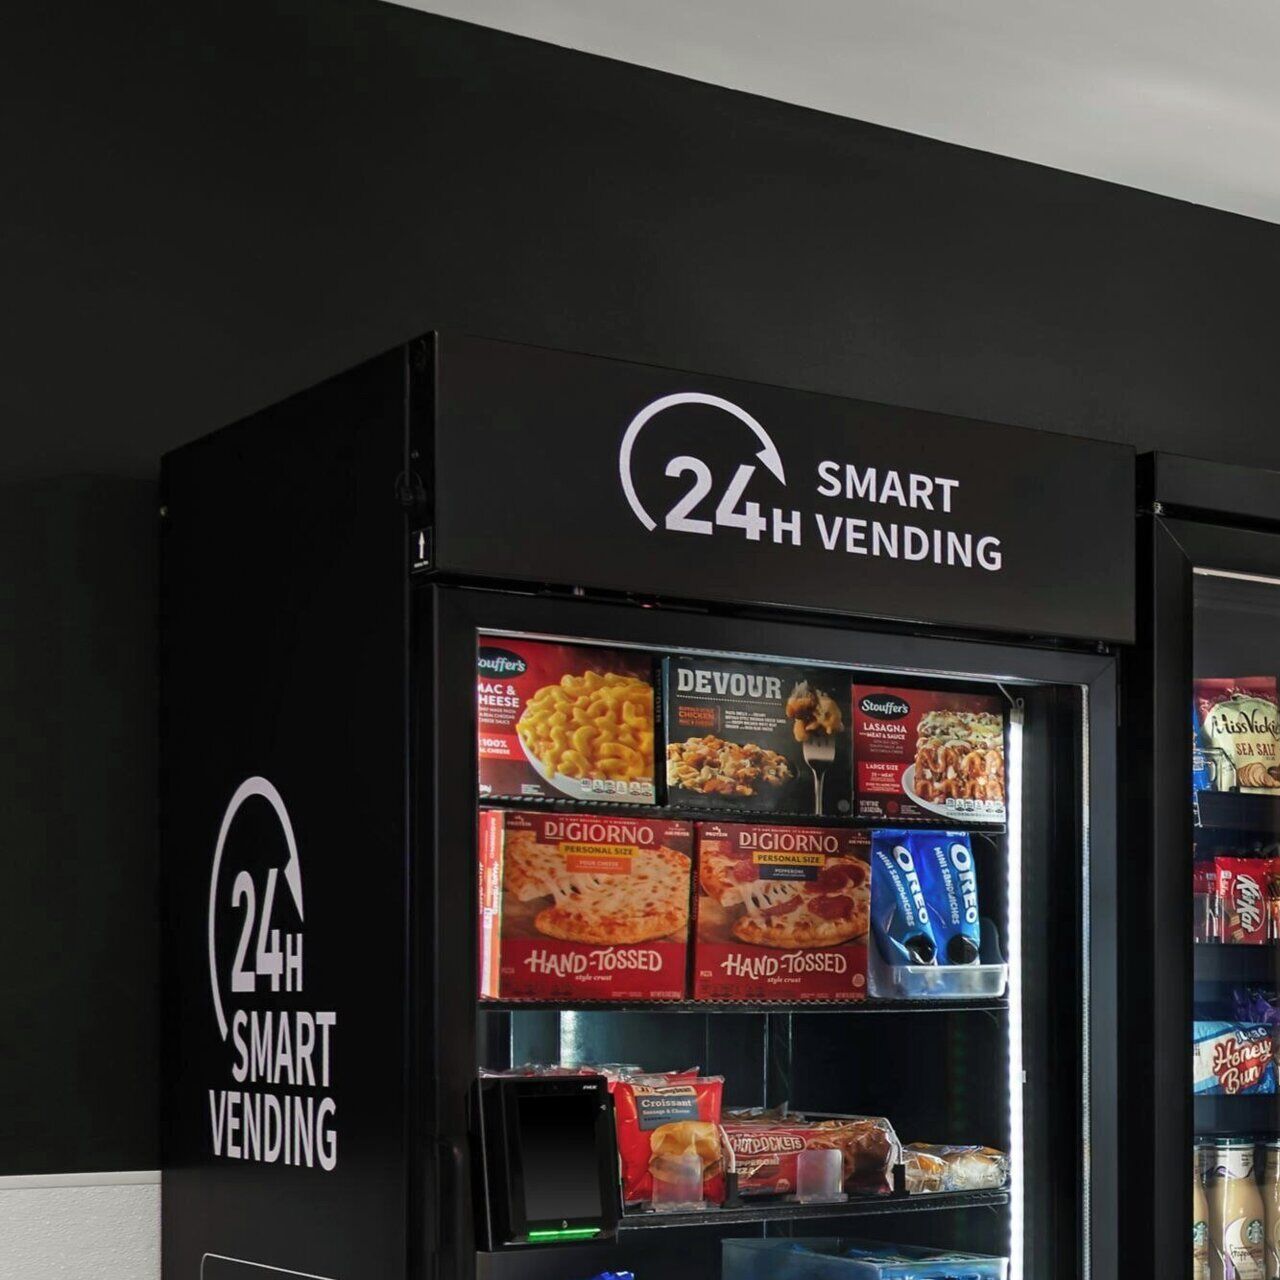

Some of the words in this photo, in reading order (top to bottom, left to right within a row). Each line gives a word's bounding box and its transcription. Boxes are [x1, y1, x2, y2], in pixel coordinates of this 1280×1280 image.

[665, 455, 801, 546] 24H
[816, 460, 960, 513] SMART
[815, 513, 1002, 571] VENDING
[478, 656, 527, 673] ouffer's
[506, 685, 516, 696] &
[677, 668, 782, 699] DEVOUR
[478, 694, 520, 708] HEESE
[861, 699, 909, 714] Stouffer's
[863, 722, 908, 733] LASAGNA
[1236, 743, 1254, 756] SEA
[564, 845, 612, 855] PERSONAL
[614, 847, 633, 856] SIZE
[757, 854, 801, 863] PERSONAL
[803, 856, 820, 864] SIZE
[893, 845, 929, 924] OREO
[950, 843, 978, 924] OREO
[231, 868, 303, 992] 24H
[524, 947, 662, 977] HAND-TOSSED
[720, 951, 847, 980] HAND-TOSSED
[231, 1009, 337, 1087] SMART
[1214, 1039, 1272, 1072] Honey
[1221, 1065, 1260, 1092] Bun
[641, 1099, 692, 1108] Croissant
[208, 1089, 337, 1172] VENDING
